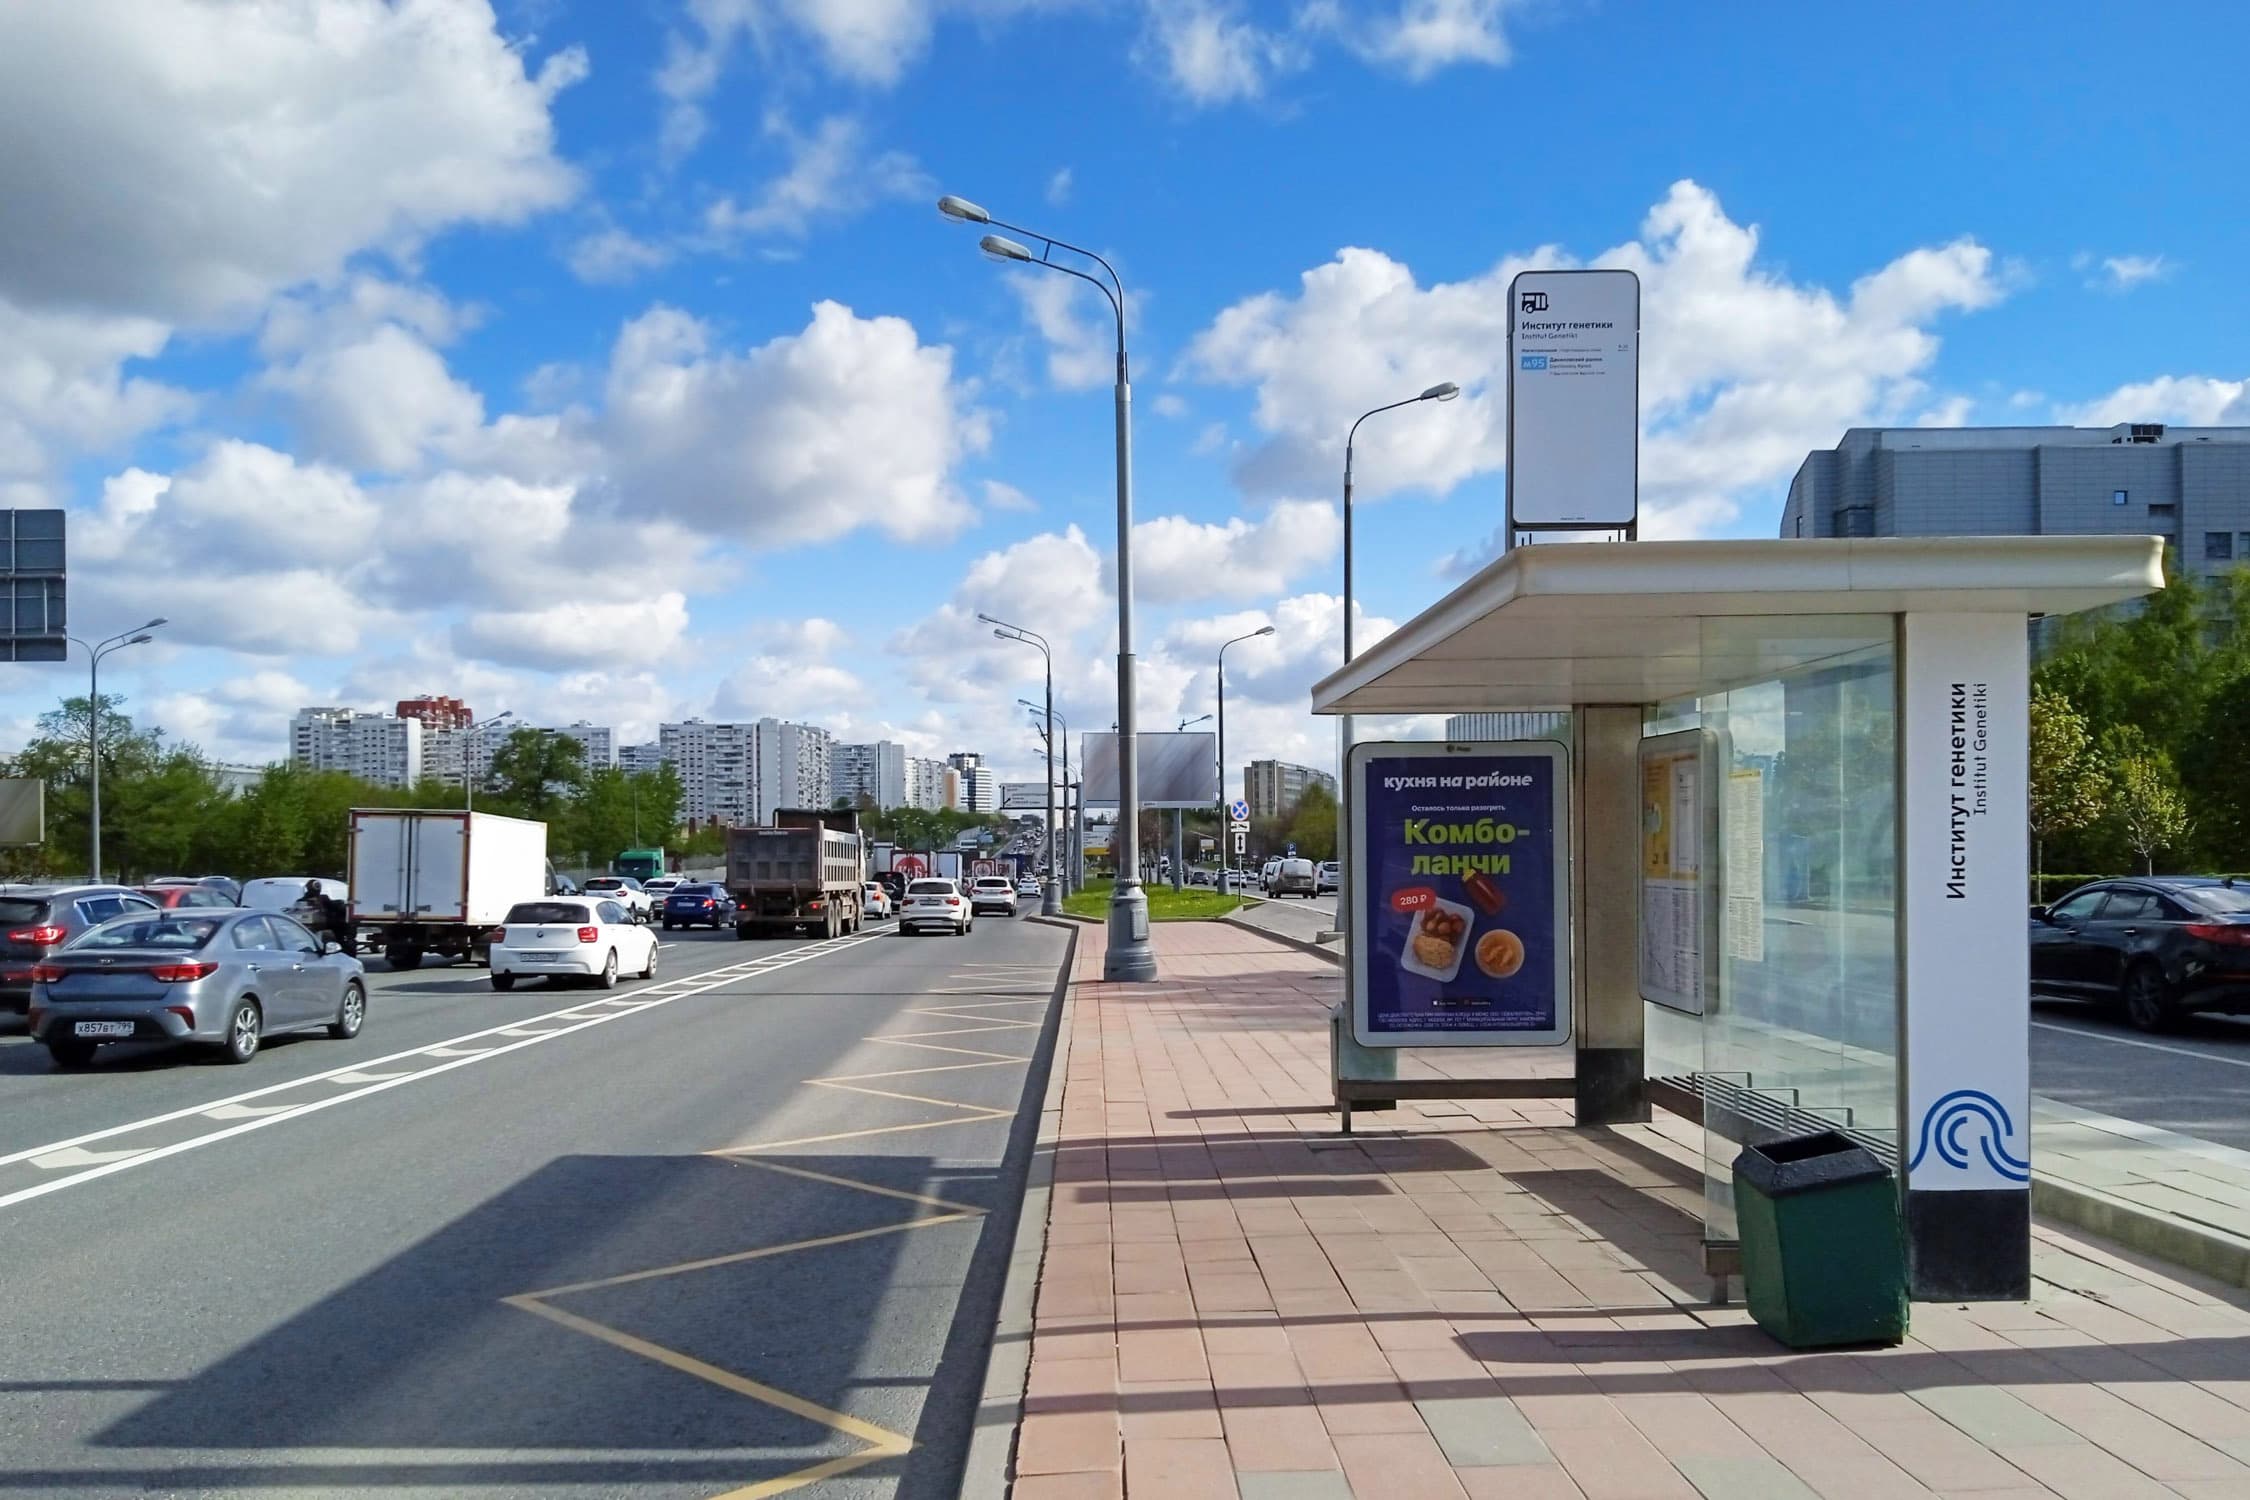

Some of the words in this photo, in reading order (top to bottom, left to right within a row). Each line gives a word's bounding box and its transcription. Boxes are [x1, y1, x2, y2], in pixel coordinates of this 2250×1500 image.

[1522, 321, 1566, 331] Институт
[1569, 321, 1613, 329] генетики
[1973, 683, 1987, 751] Genetiki
[1951, 683, 1966, 787] генетики
[1384, 776, 1436, 791] кухня
[1440, 776, 1463, 788] на
[1465, 771, 1533, 790] районе
[1973, 757, 1987, 815] Institut
[1404, 818, 1531, 845] Комбо-
[1946, 794, 1970, 898] Институт
[1411, 854, 1511, 876] ланчи
[1400, 896, 1419, 905] 280
